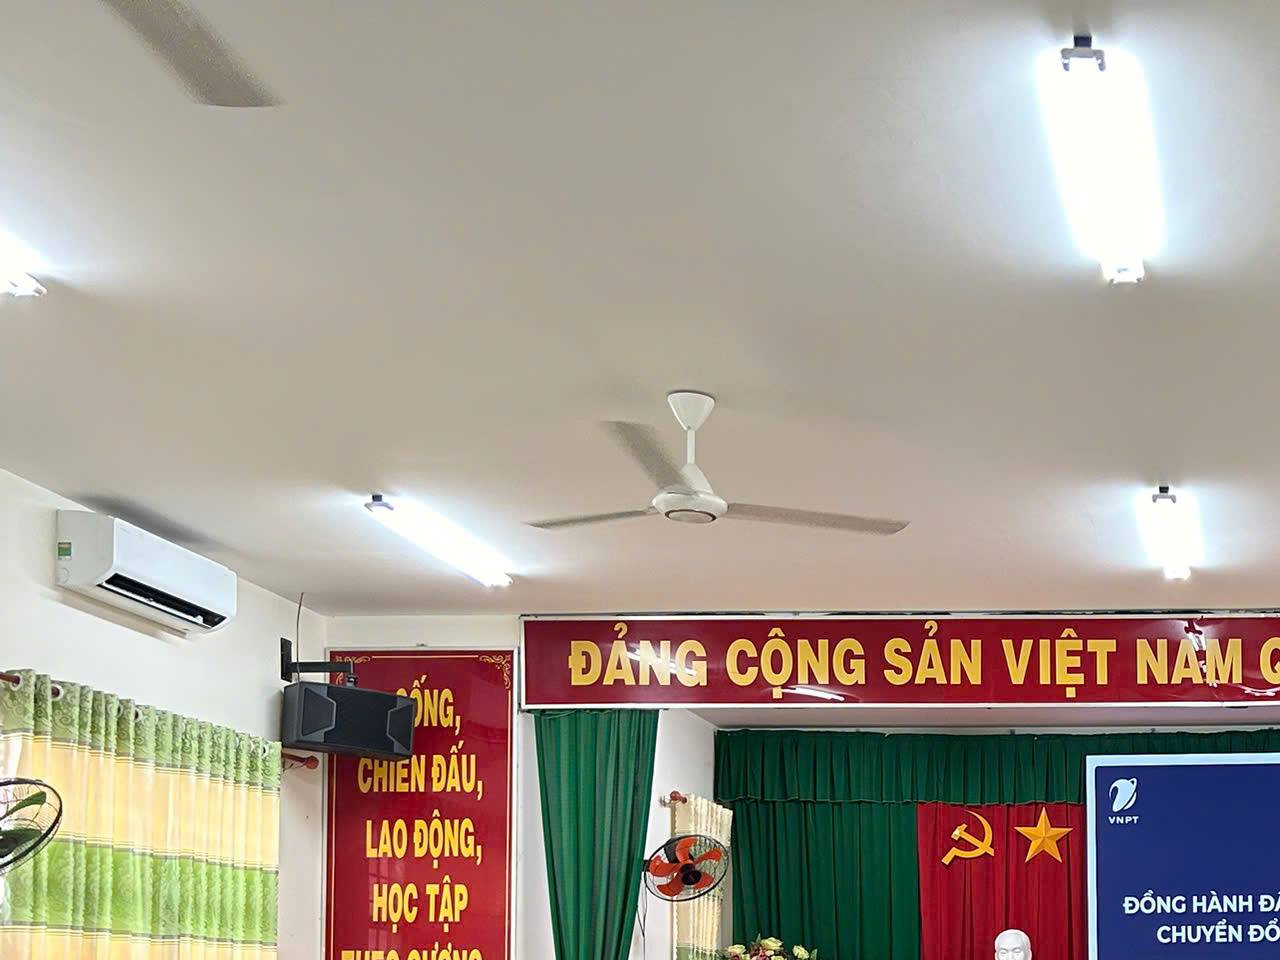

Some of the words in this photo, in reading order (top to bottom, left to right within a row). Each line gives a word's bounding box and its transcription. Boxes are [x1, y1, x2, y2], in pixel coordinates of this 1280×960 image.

[569, 621, 707, 687] ĐẢNG
[725, 627, 866, 699] CỘNG
[884, 620, 984, 685] SẢN
[1002, 629, 1116, 697] VIỆT
[1137, 637, 1242, 686] NAM
[396, 675, 460, 735] ỐNG,
[432, 741, 482, 800] ĐẤU,
[366, 819, 407, 858] LAO
[413, 809, 481, 868] ĐỘNG,
[1109, 816, 1139, 824] VNPT
[373, 883, 418, 933] HỌC
[426, 875, 468, 932] TẬP
[1123, 890, 1186, 913] ĐỒNG
[1193, 891, 1252, 912] HÀNH
[1157, 919, 1242, 943] CHUYỂN
